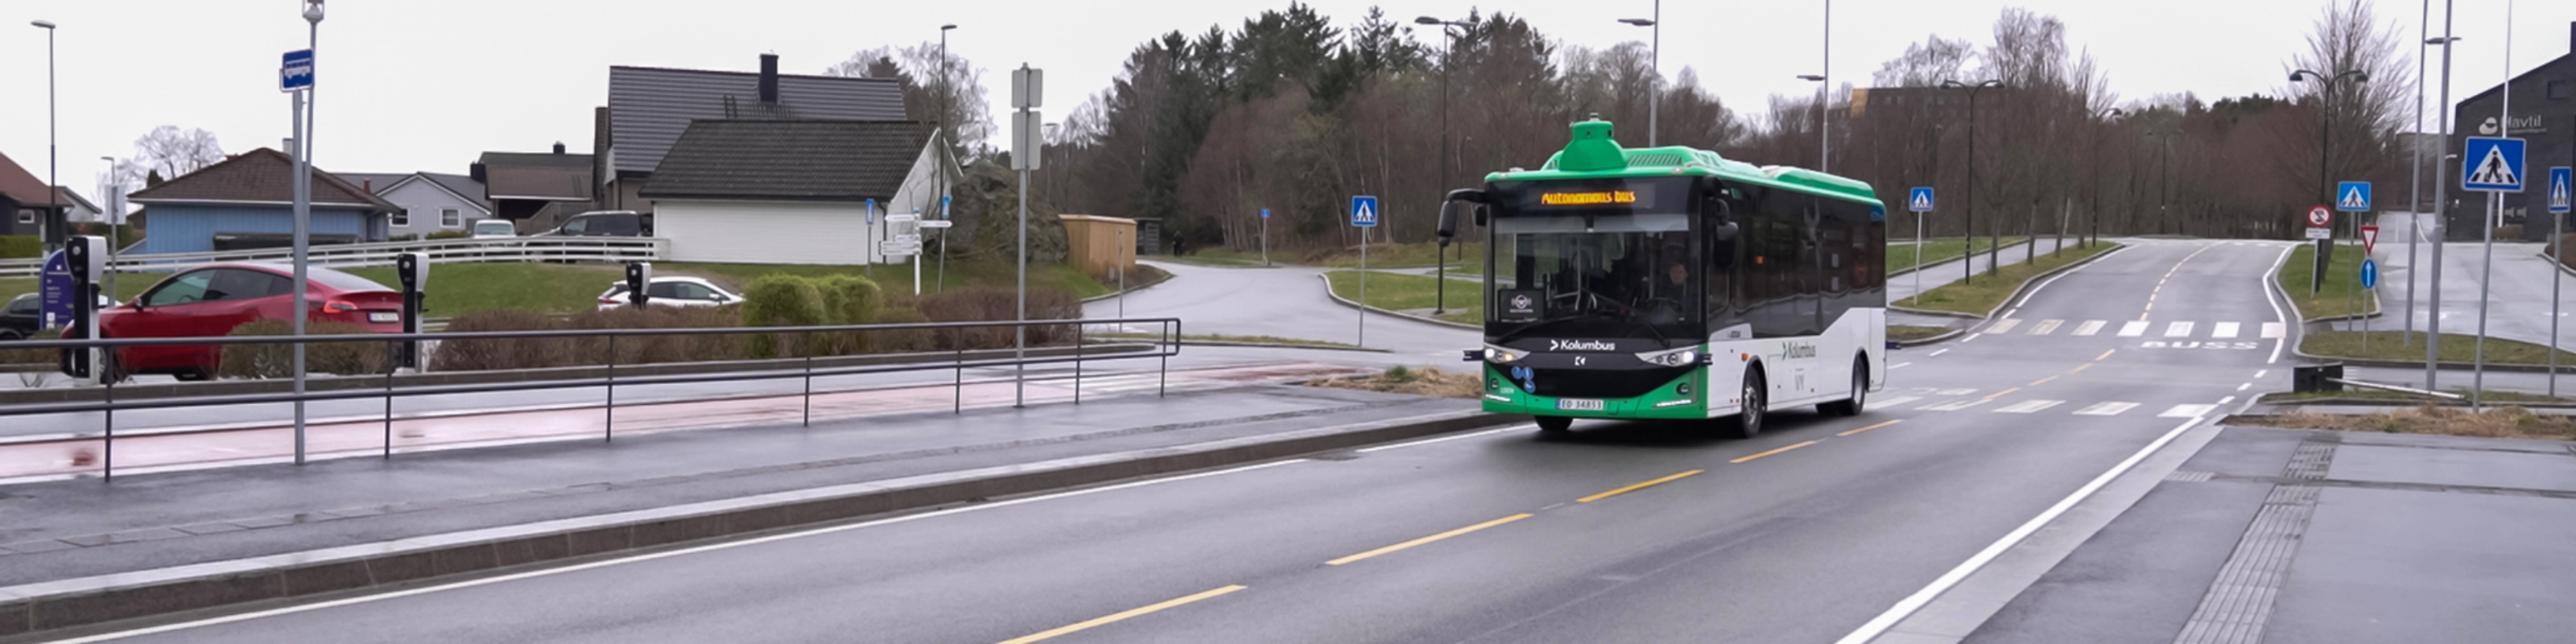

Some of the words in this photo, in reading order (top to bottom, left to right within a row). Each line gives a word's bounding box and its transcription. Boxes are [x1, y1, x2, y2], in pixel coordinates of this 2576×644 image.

[1542, 192, 1612, 204] Autonomous
[1614, 191, 1636, 203] bus
[1561, 340, 1616, 350] Kolumbus
[1788, 341, 1816, 358] Kolumbus
